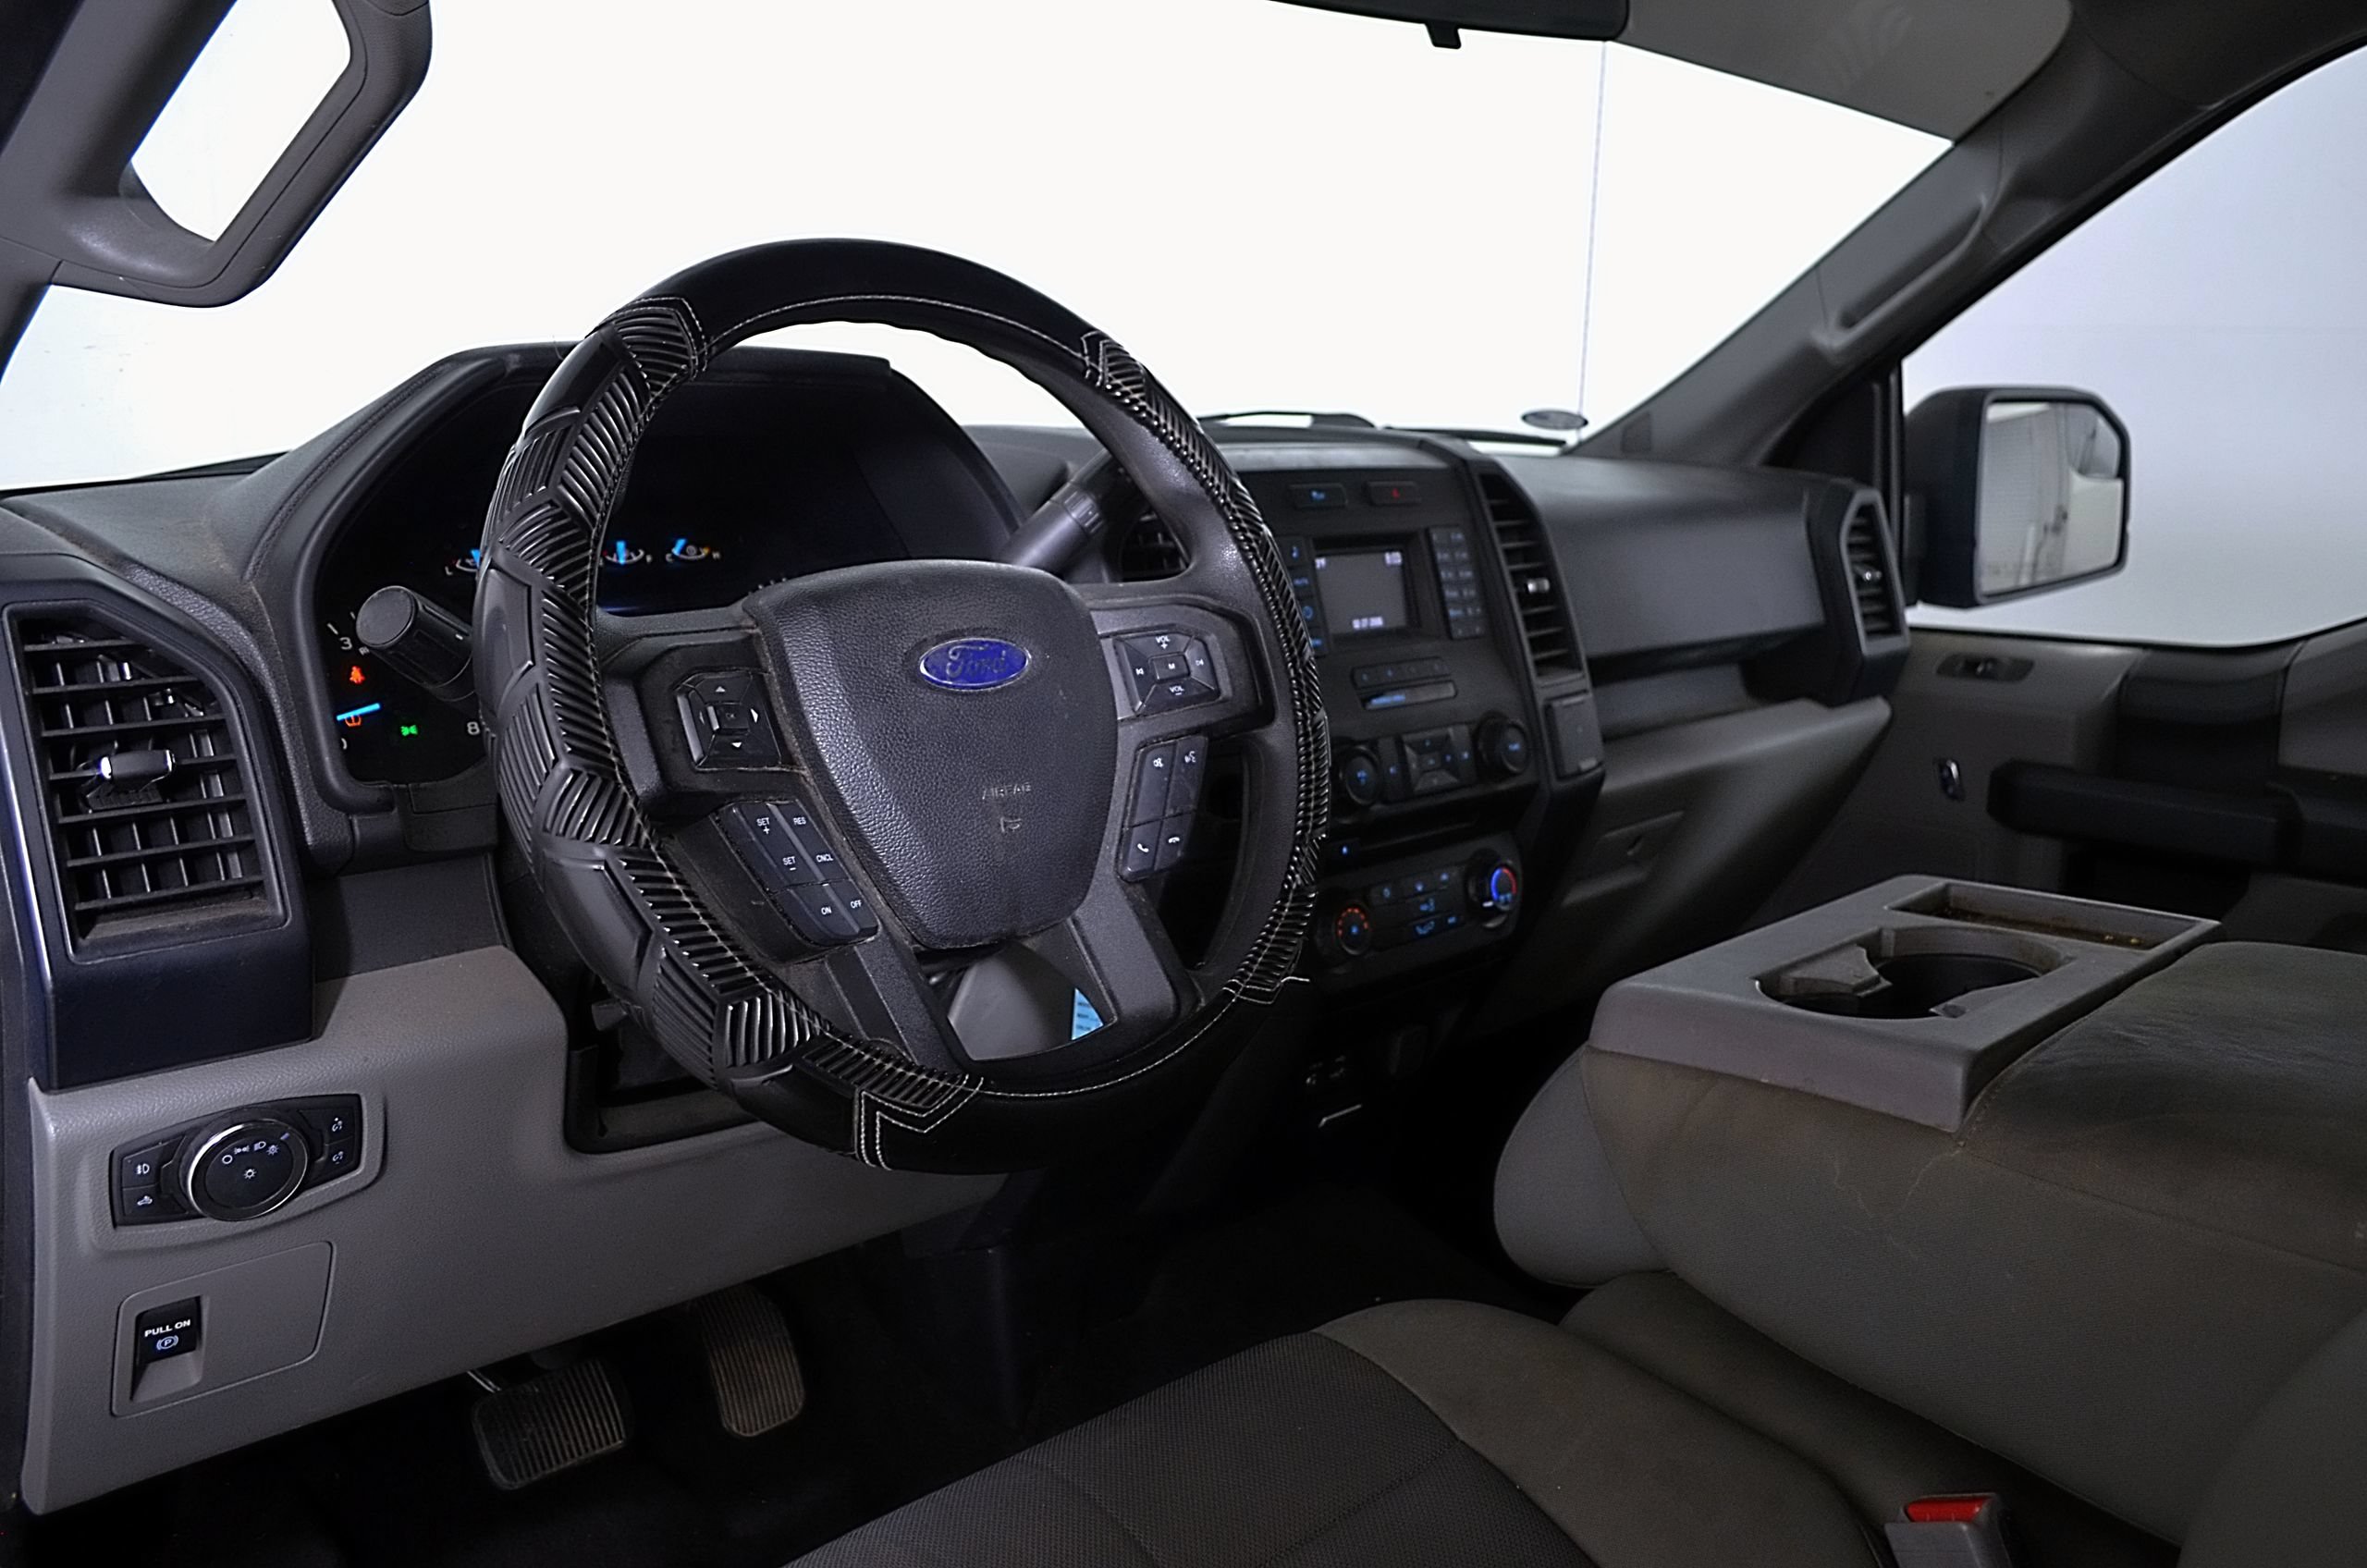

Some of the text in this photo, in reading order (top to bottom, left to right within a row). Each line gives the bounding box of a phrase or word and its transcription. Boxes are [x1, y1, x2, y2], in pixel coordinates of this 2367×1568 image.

[338, 636, 352, 651] 3
[1155, 635, 1171, 644] VOL
[946, 643, 1007, 680] Ford
[1168, 662, 1176, 670] M
[1169, 684, 1184, 693] VOL
[466, 721, 481, 736] 8
[756, 816, 770, 827] SET
[792, 816, 807, 826] RES
[782, 855, 796, 866] SET
[816, 853, 834, 864] CNCL
[820, 905, 832, 915] ON
[850, 899, 863, 910] OFF
[144, 1318, 191, 1337] PULL ON
